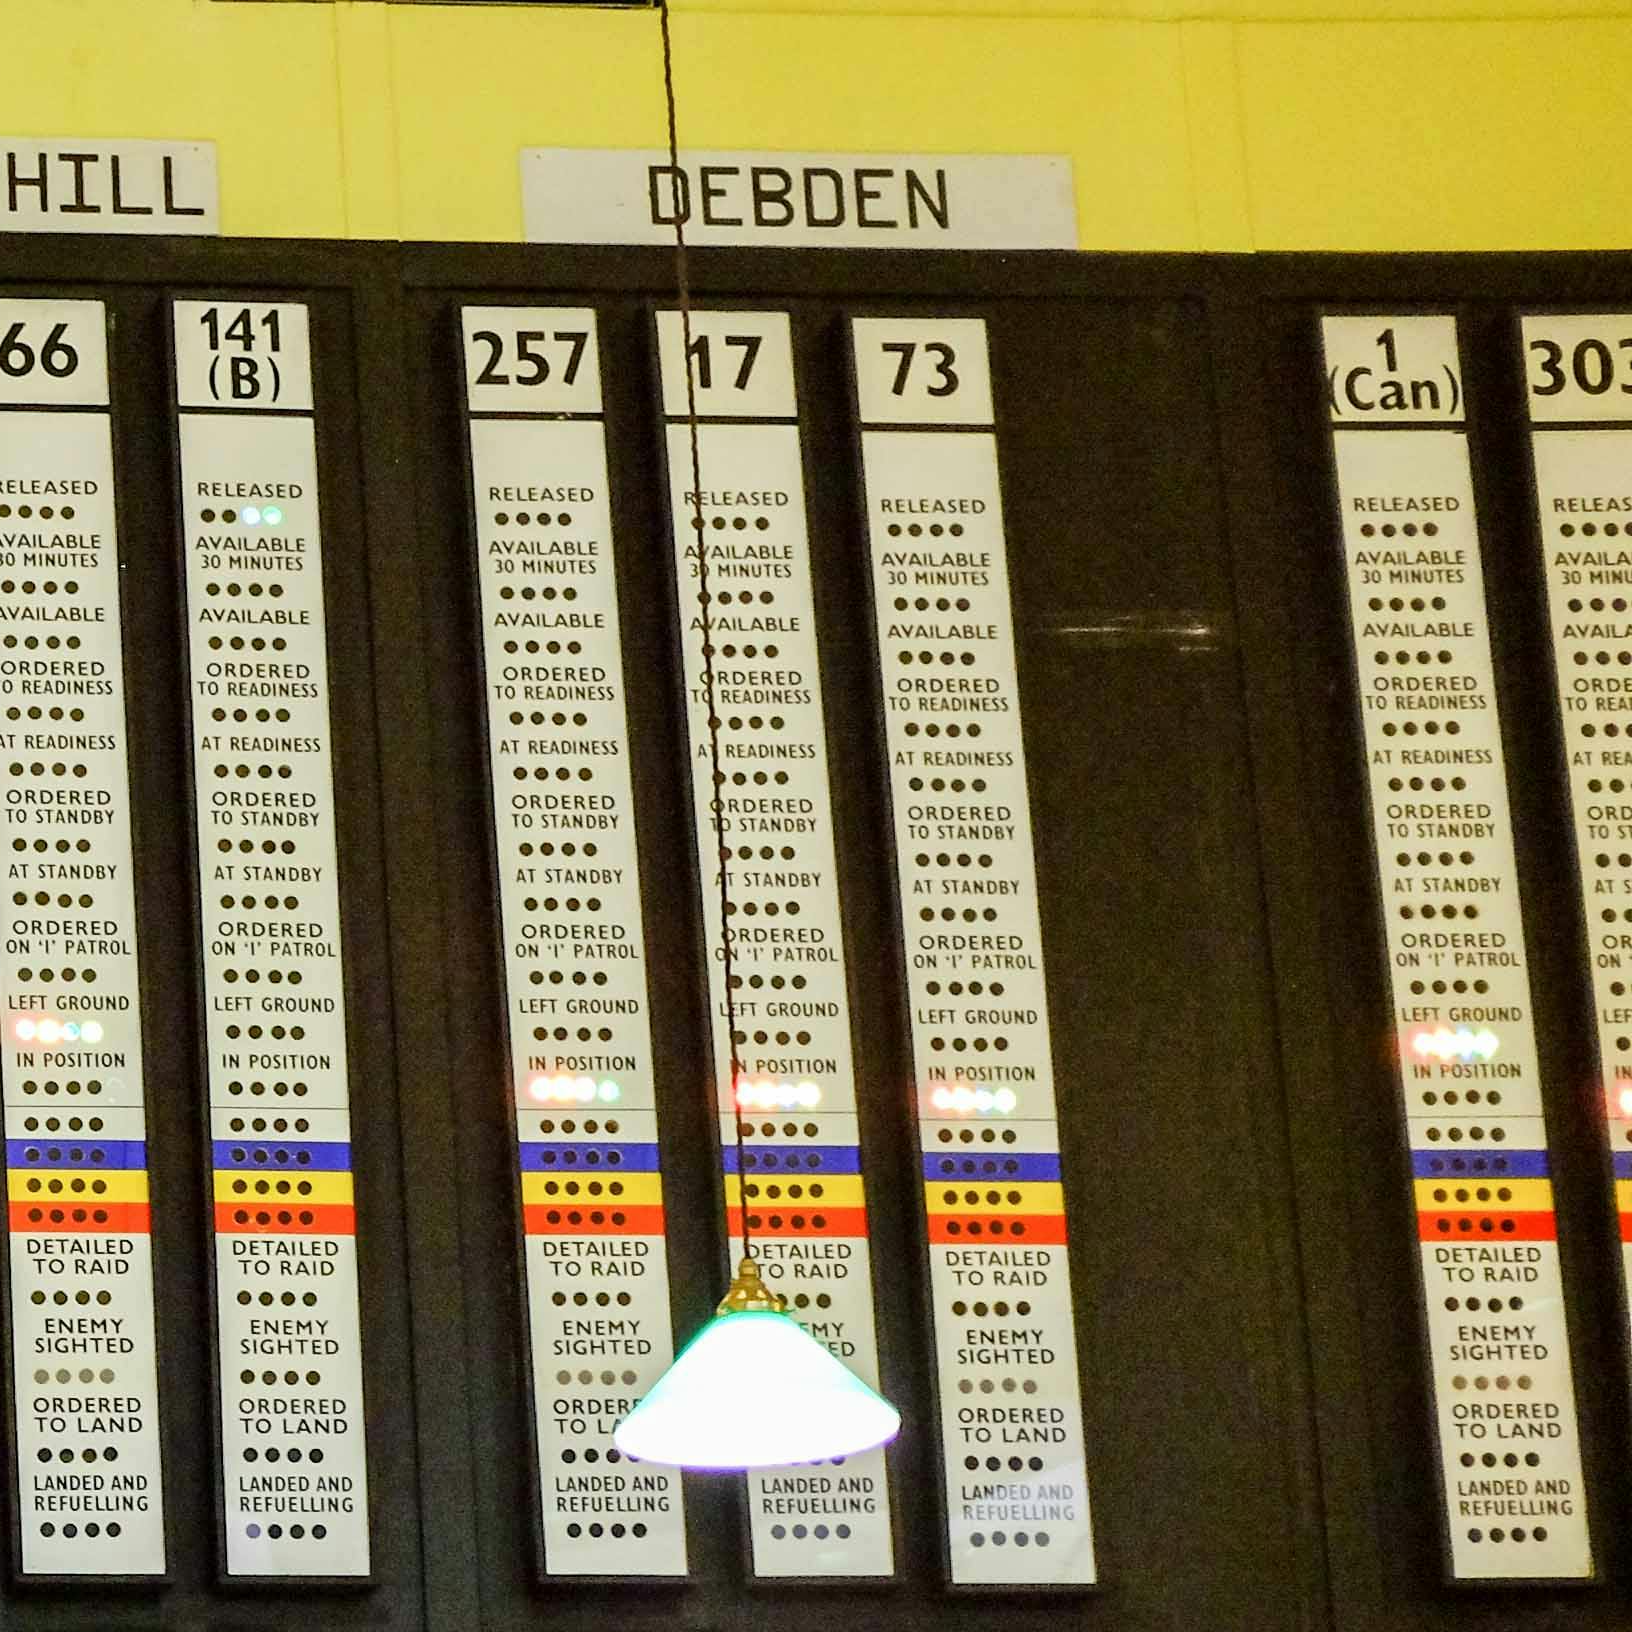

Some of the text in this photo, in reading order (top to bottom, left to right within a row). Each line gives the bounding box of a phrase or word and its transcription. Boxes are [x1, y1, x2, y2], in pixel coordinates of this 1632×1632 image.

[7, 152, 204, 215] HILL
[649, 162, 948, 233] DEBDEN
[201, 308, 280, 352] 141
[1377, 329, 1396, 372] 1
[473, 331, 588, 386] 257
[684, 331, 762, 394] 17
[882, 343, 958, 396] 73
[209, 356, 280, 402] (B)
[1325, 360, 1458, 419] (Can)
[489, 487, 594, 502] RELEASED
[489, 541, 598, 555] AVAILABLE
[496, 559, 596, 574] 30 MINUTES
[27, 1239, 133, 1254] DETAILED
[1435, 1247, 1541, 1263] DETAILED
[33, 1259, 129, 1274] TO RAID
[1443, 1267, 1538, 1282] TO RAID
[45, 1318, 122, 1333] ENEMY
[1458, 1326, 1535, 1341] ENEMY
[35, 1338, 134, 1353] SIGHTED
[1450, 1345, 1548, 1360] SIGHTED
[33, 1398, 141, 1413] ORDERED
[34, 1417, 142, 1433] TO LAND
[34, 1475, 147, 1491] LANDED AND
[35, 1496, 148, 1511] REFUELLING
